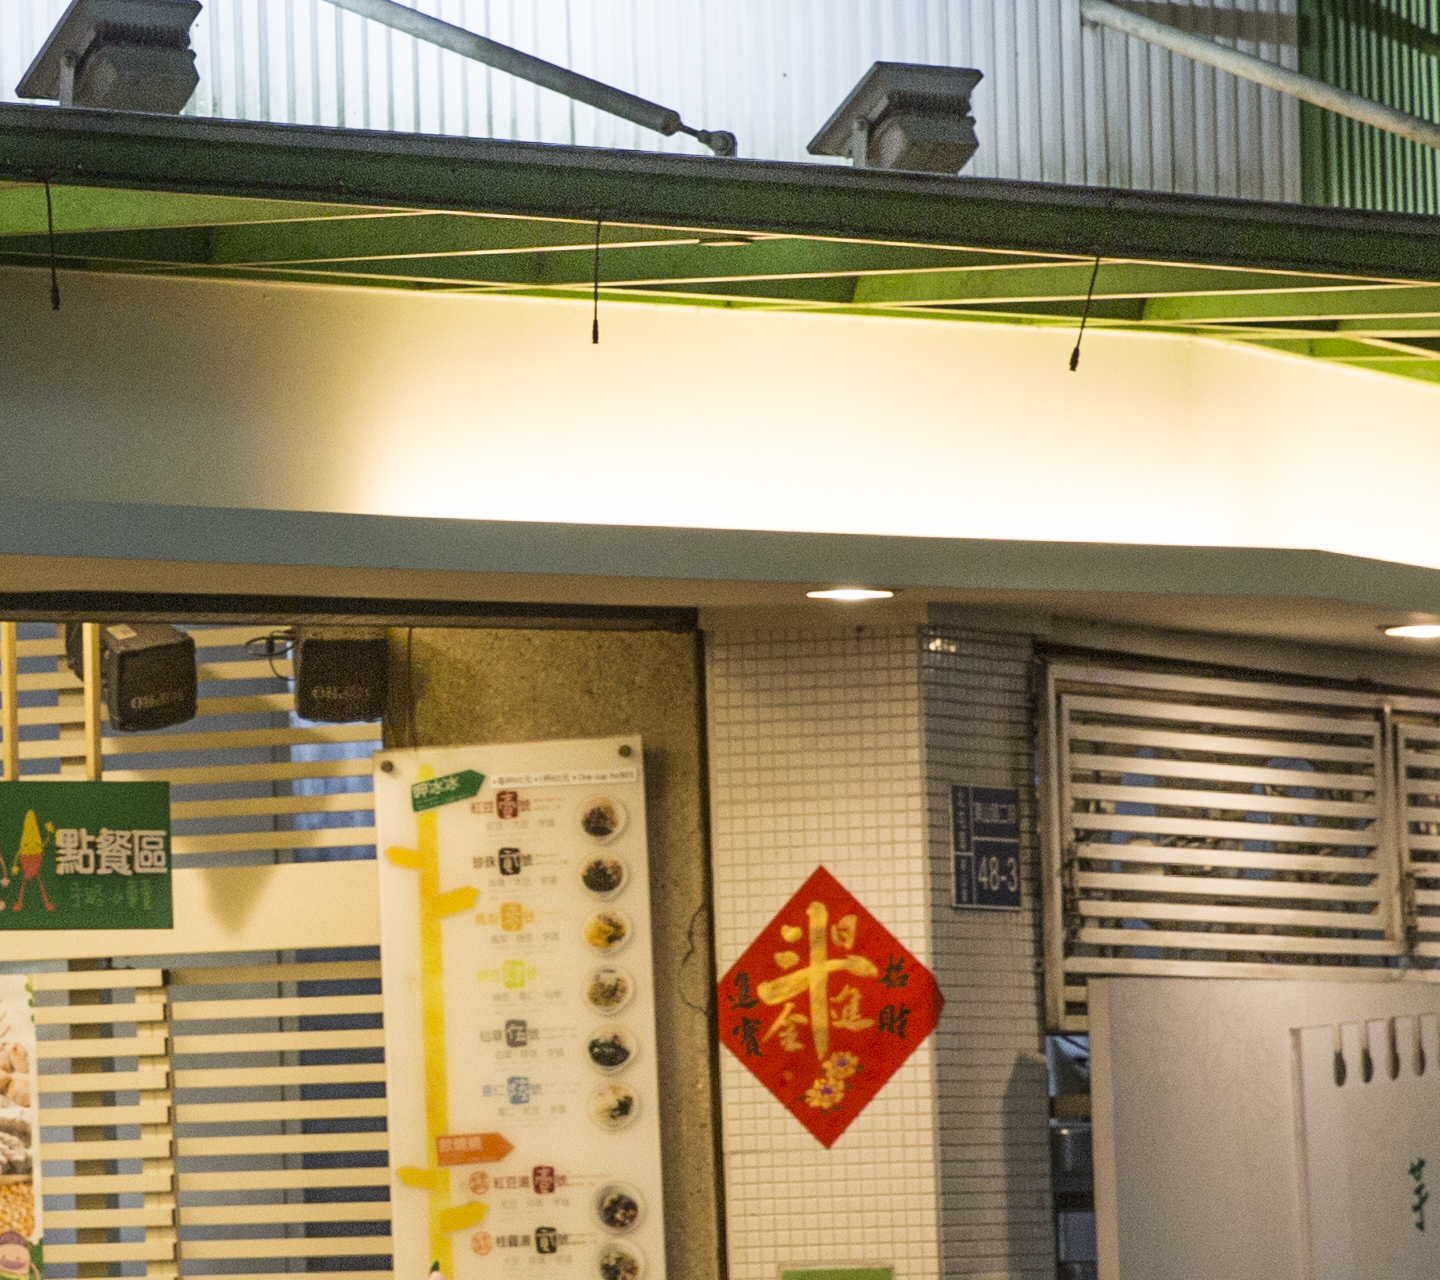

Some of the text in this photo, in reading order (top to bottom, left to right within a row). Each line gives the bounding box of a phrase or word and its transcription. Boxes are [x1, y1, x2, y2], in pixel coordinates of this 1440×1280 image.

[55, 827, 168, 876] 點餐區
[977, 854, 1018, 892] 48-3
